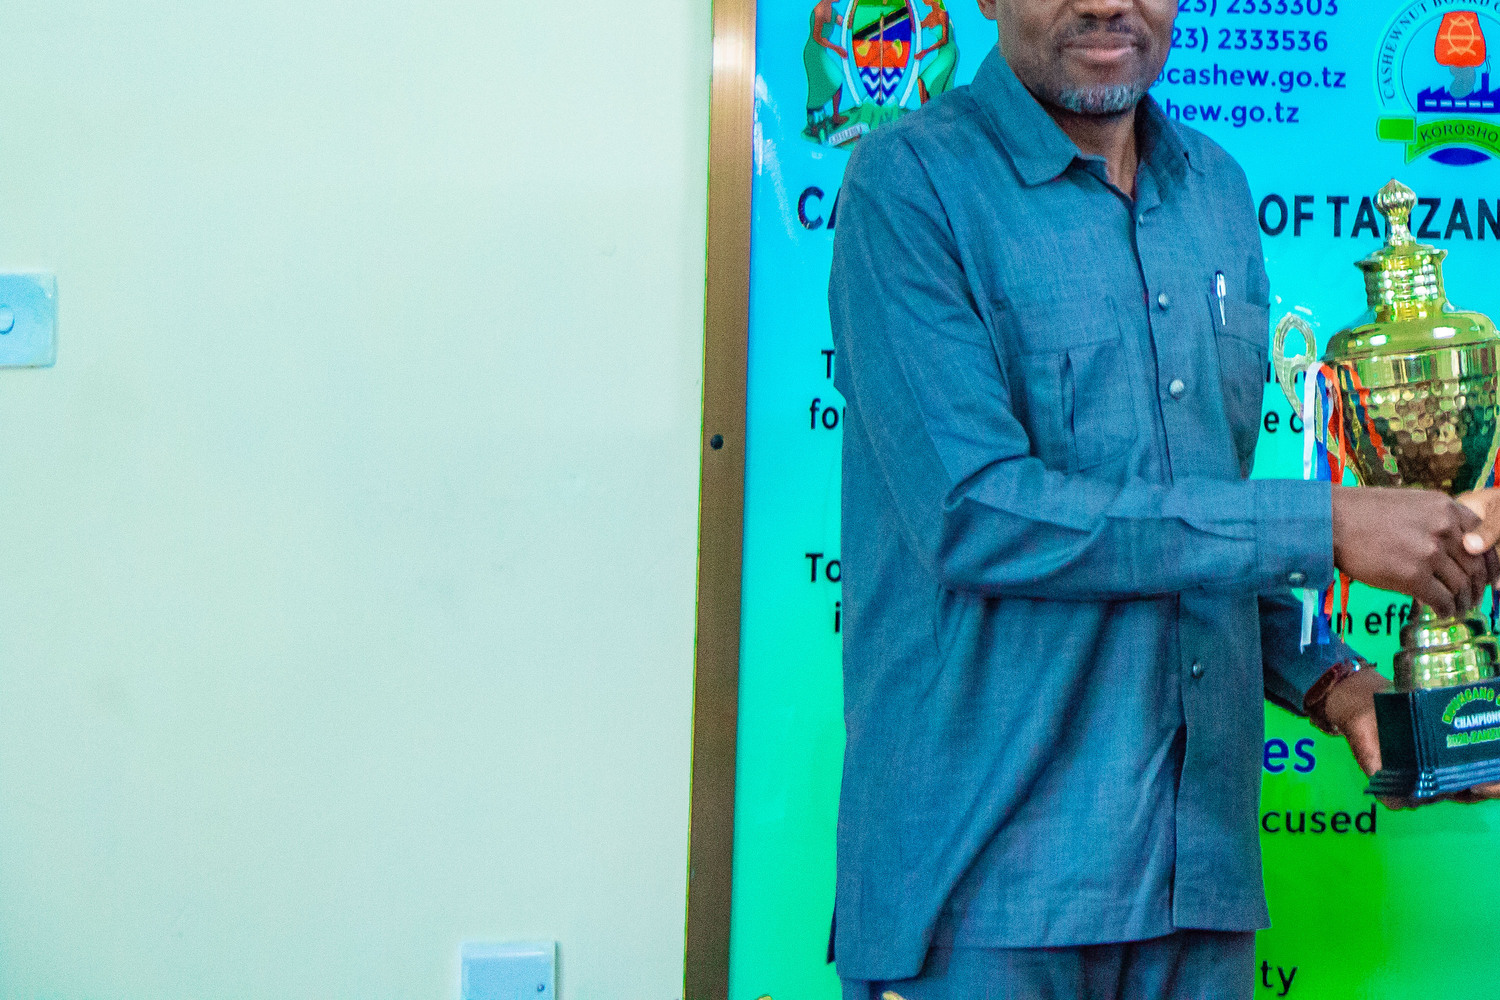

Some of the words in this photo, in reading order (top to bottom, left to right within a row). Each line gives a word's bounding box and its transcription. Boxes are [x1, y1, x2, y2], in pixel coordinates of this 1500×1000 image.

[1171, 26, 1209, 53] 23)
[1218, 28, 1328, 52] 2333536
[1381, 2, 1429, 100] CASHEWNUT
[1157, 63, 1346, 93] cashew.go.tz
[1165, 98, 1299, 128] hew.go.tz
[1420, 123, 1499, 143] KOROSHO
[1258, 193, 1315, 238] OF
[809, 397, 846, 430] fo
[1261, 802, 1377, 834] cused
